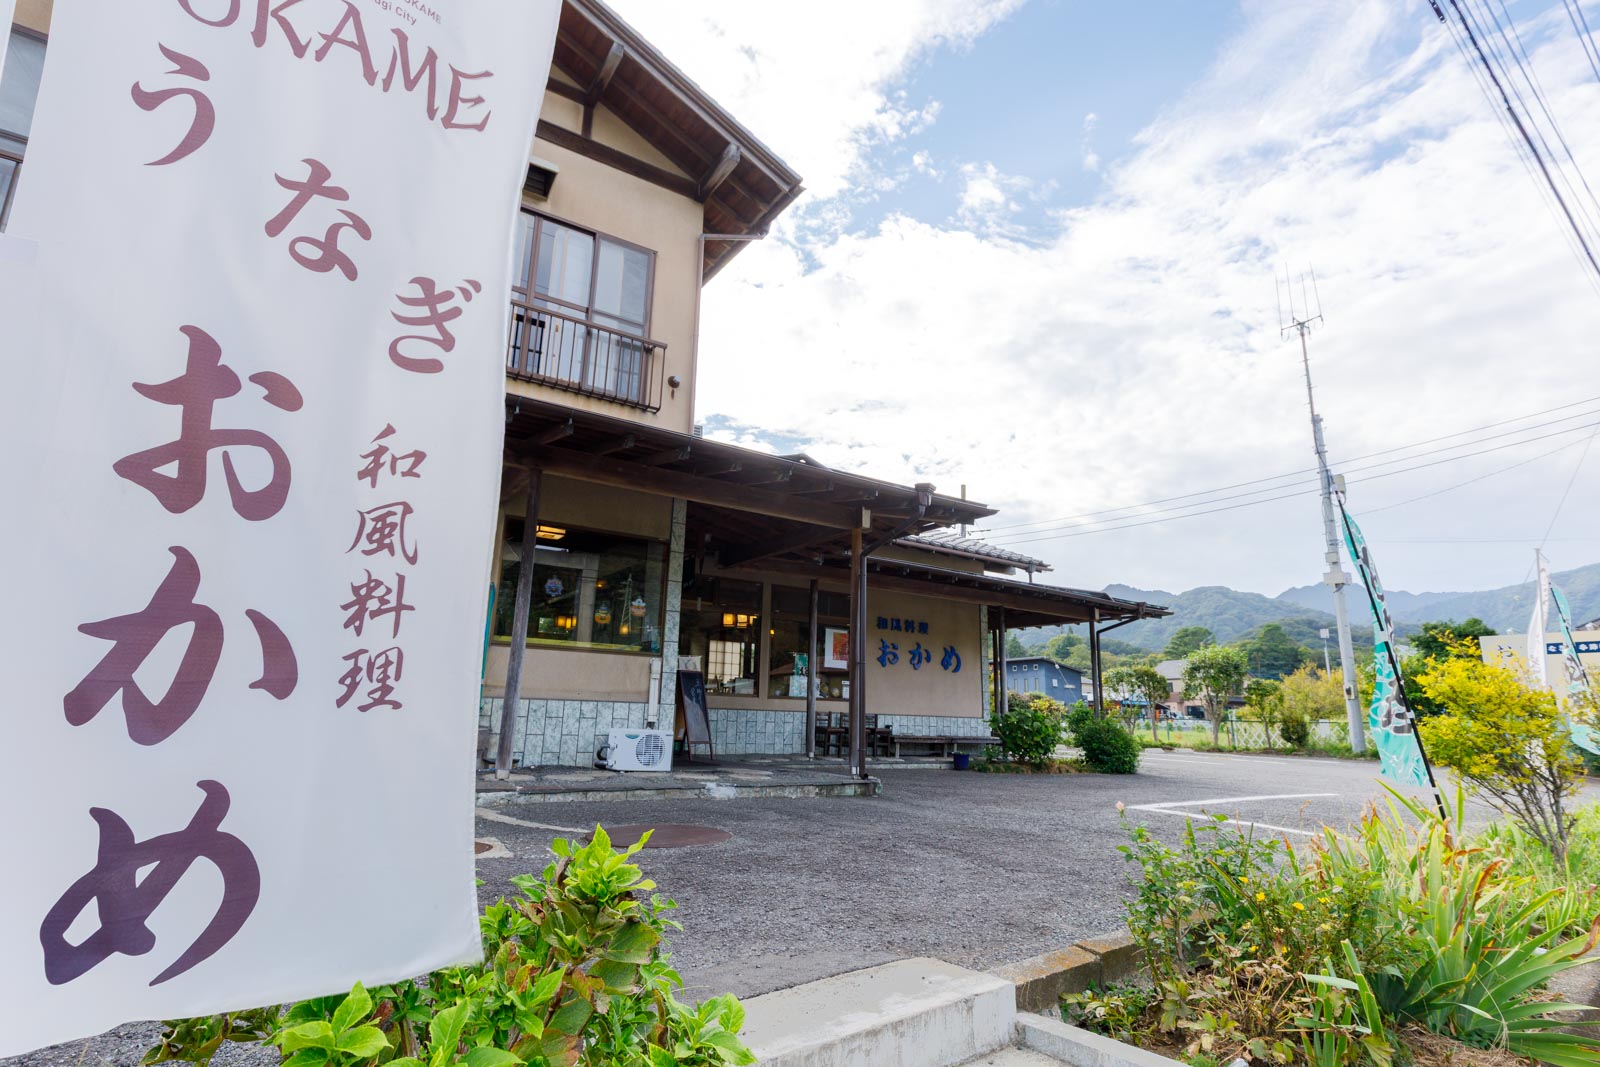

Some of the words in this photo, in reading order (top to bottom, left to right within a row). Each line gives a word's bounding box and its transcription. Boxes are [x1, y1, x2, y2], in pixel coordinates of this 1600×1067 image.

[395, 6, 417, 26] City
[130, 41, 482, 375] うなぎ
[40, 324, 304, 987] おかめ
[335, 423, 427, 713] 和風料理
[877, 638, 962, 673] おかめ
